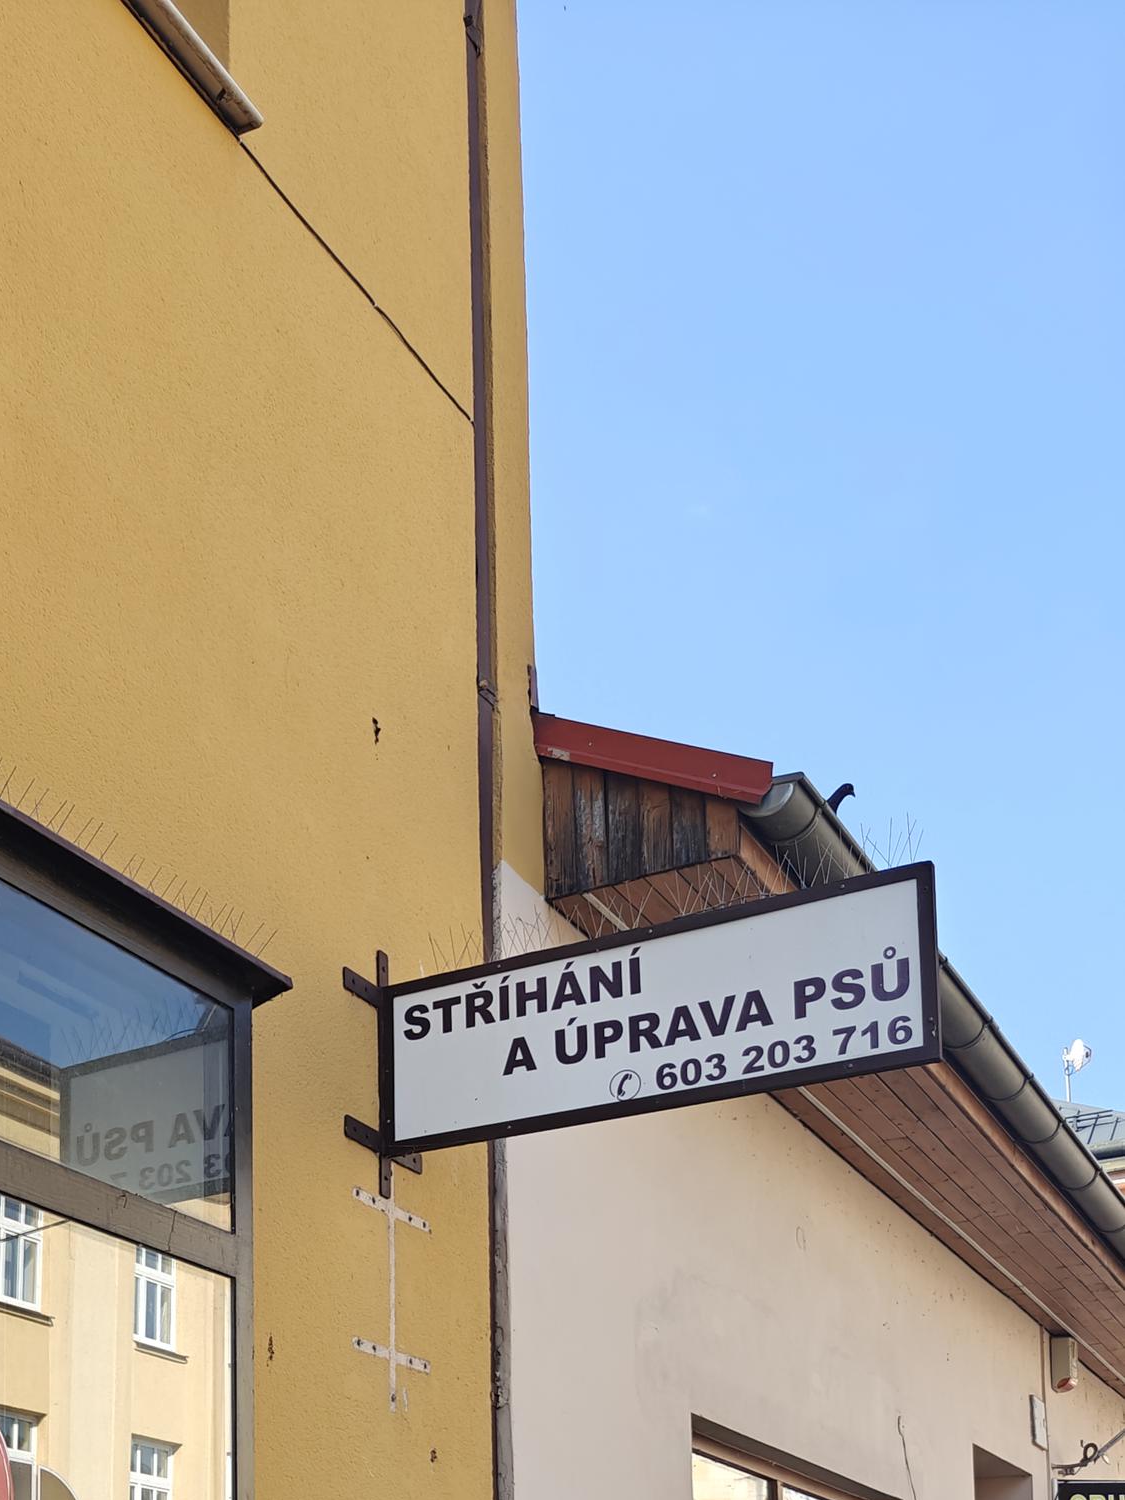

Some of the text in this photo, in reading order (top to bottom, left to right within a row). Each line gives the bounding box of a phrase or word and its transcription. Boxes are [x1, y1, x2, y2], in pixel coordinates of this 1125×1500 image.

[402, 945, 642, 1041] STŘÍHÁNÍ
[502, 946, 911, 1076] A ÚPRAVA PSŮ
[655, 1015, 914, 1091] 603 203 716
